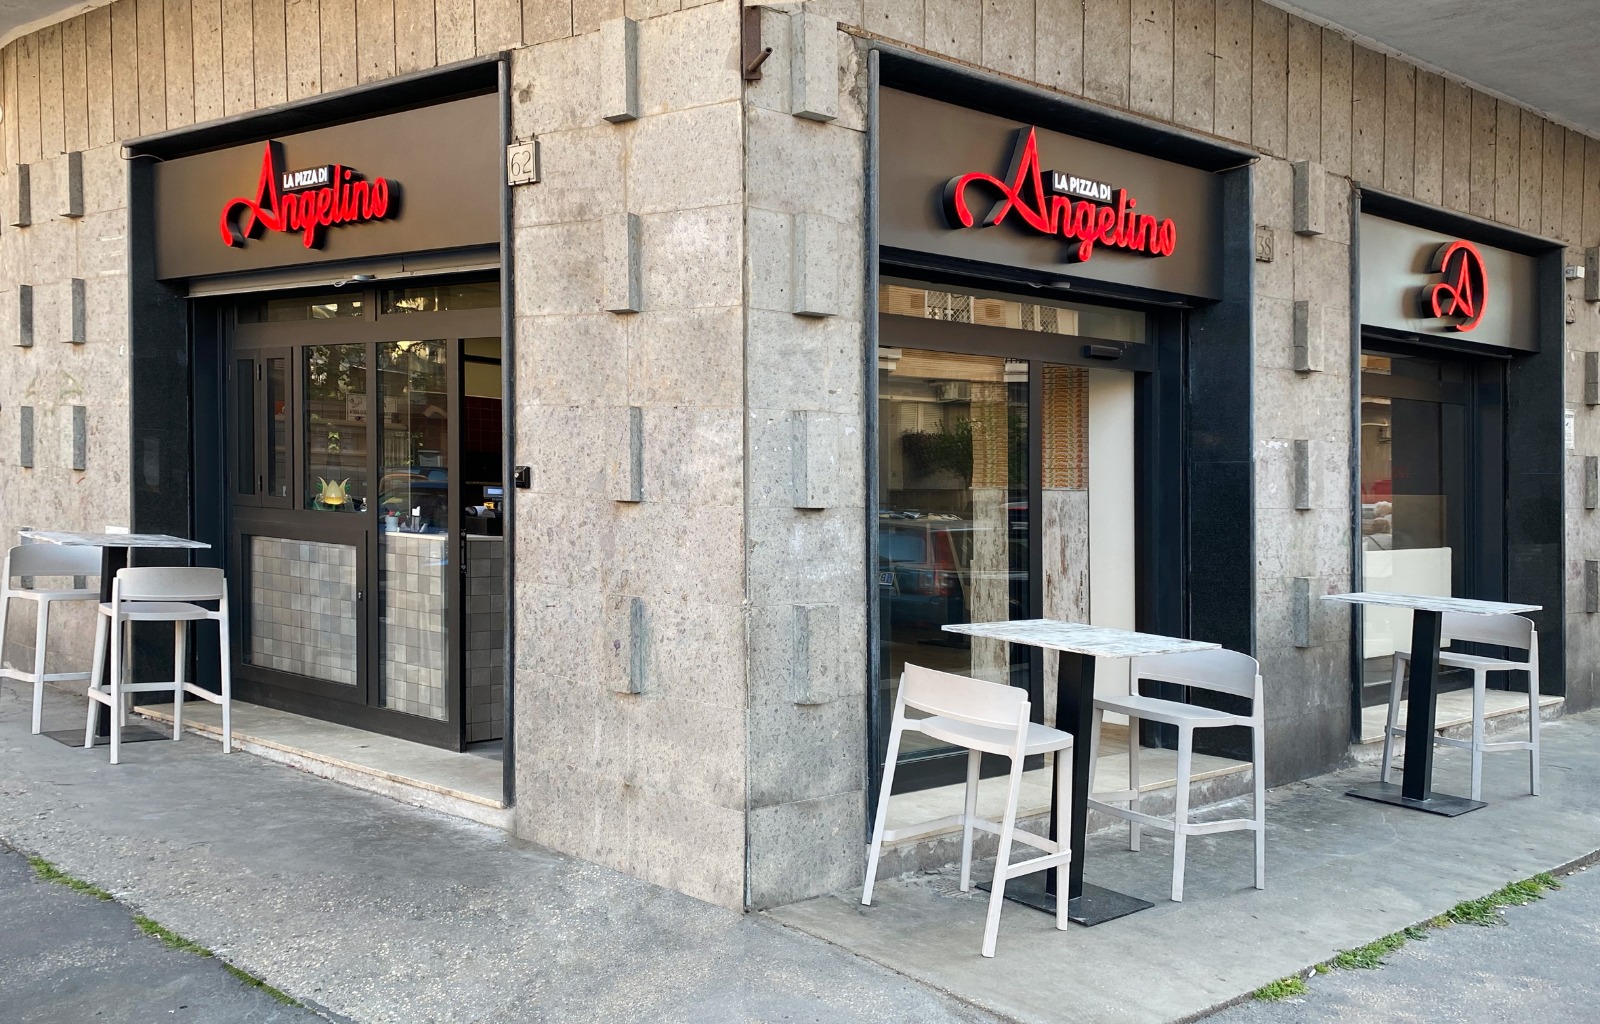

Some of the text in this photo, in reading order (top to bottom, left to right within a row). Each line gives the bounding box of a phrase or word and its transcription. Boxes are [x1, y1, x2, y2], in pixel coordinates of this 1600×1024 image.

[283, 167, 327, 188] LA PIZZA DI
[511, 150, 531, 177] 62
[220, 140, 389, 248] Angelino
[955, 125, 1177, 262] Angelino
[1054, 172, 1111, 201] LA PIZZA DI
